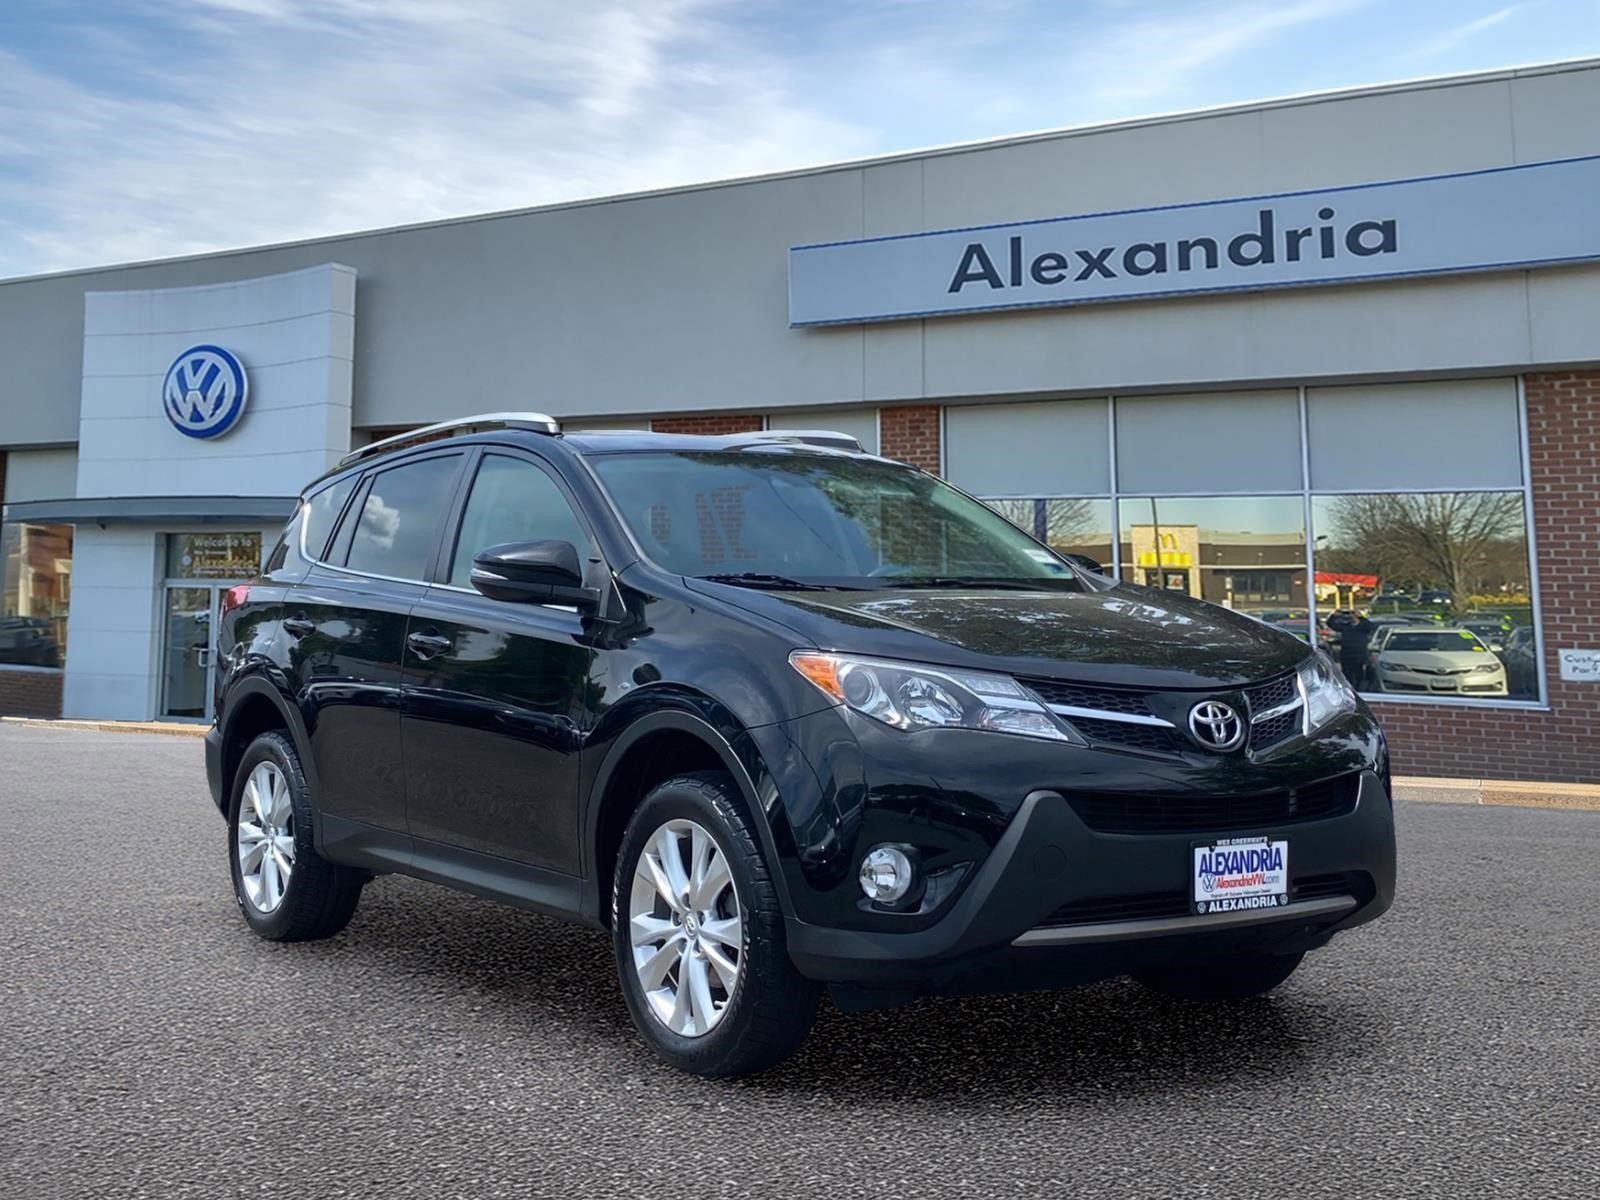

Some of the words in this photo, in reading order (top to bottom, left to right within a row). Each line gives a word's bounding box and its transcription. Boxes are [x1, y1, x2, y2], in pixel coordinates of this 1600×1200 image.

[947, 206, 1398, 295] Alexandria
[1198, 847, 1283, 878] ALEXANDRIA
[1208, 895, 1278, 913] ALEXANDRIA
